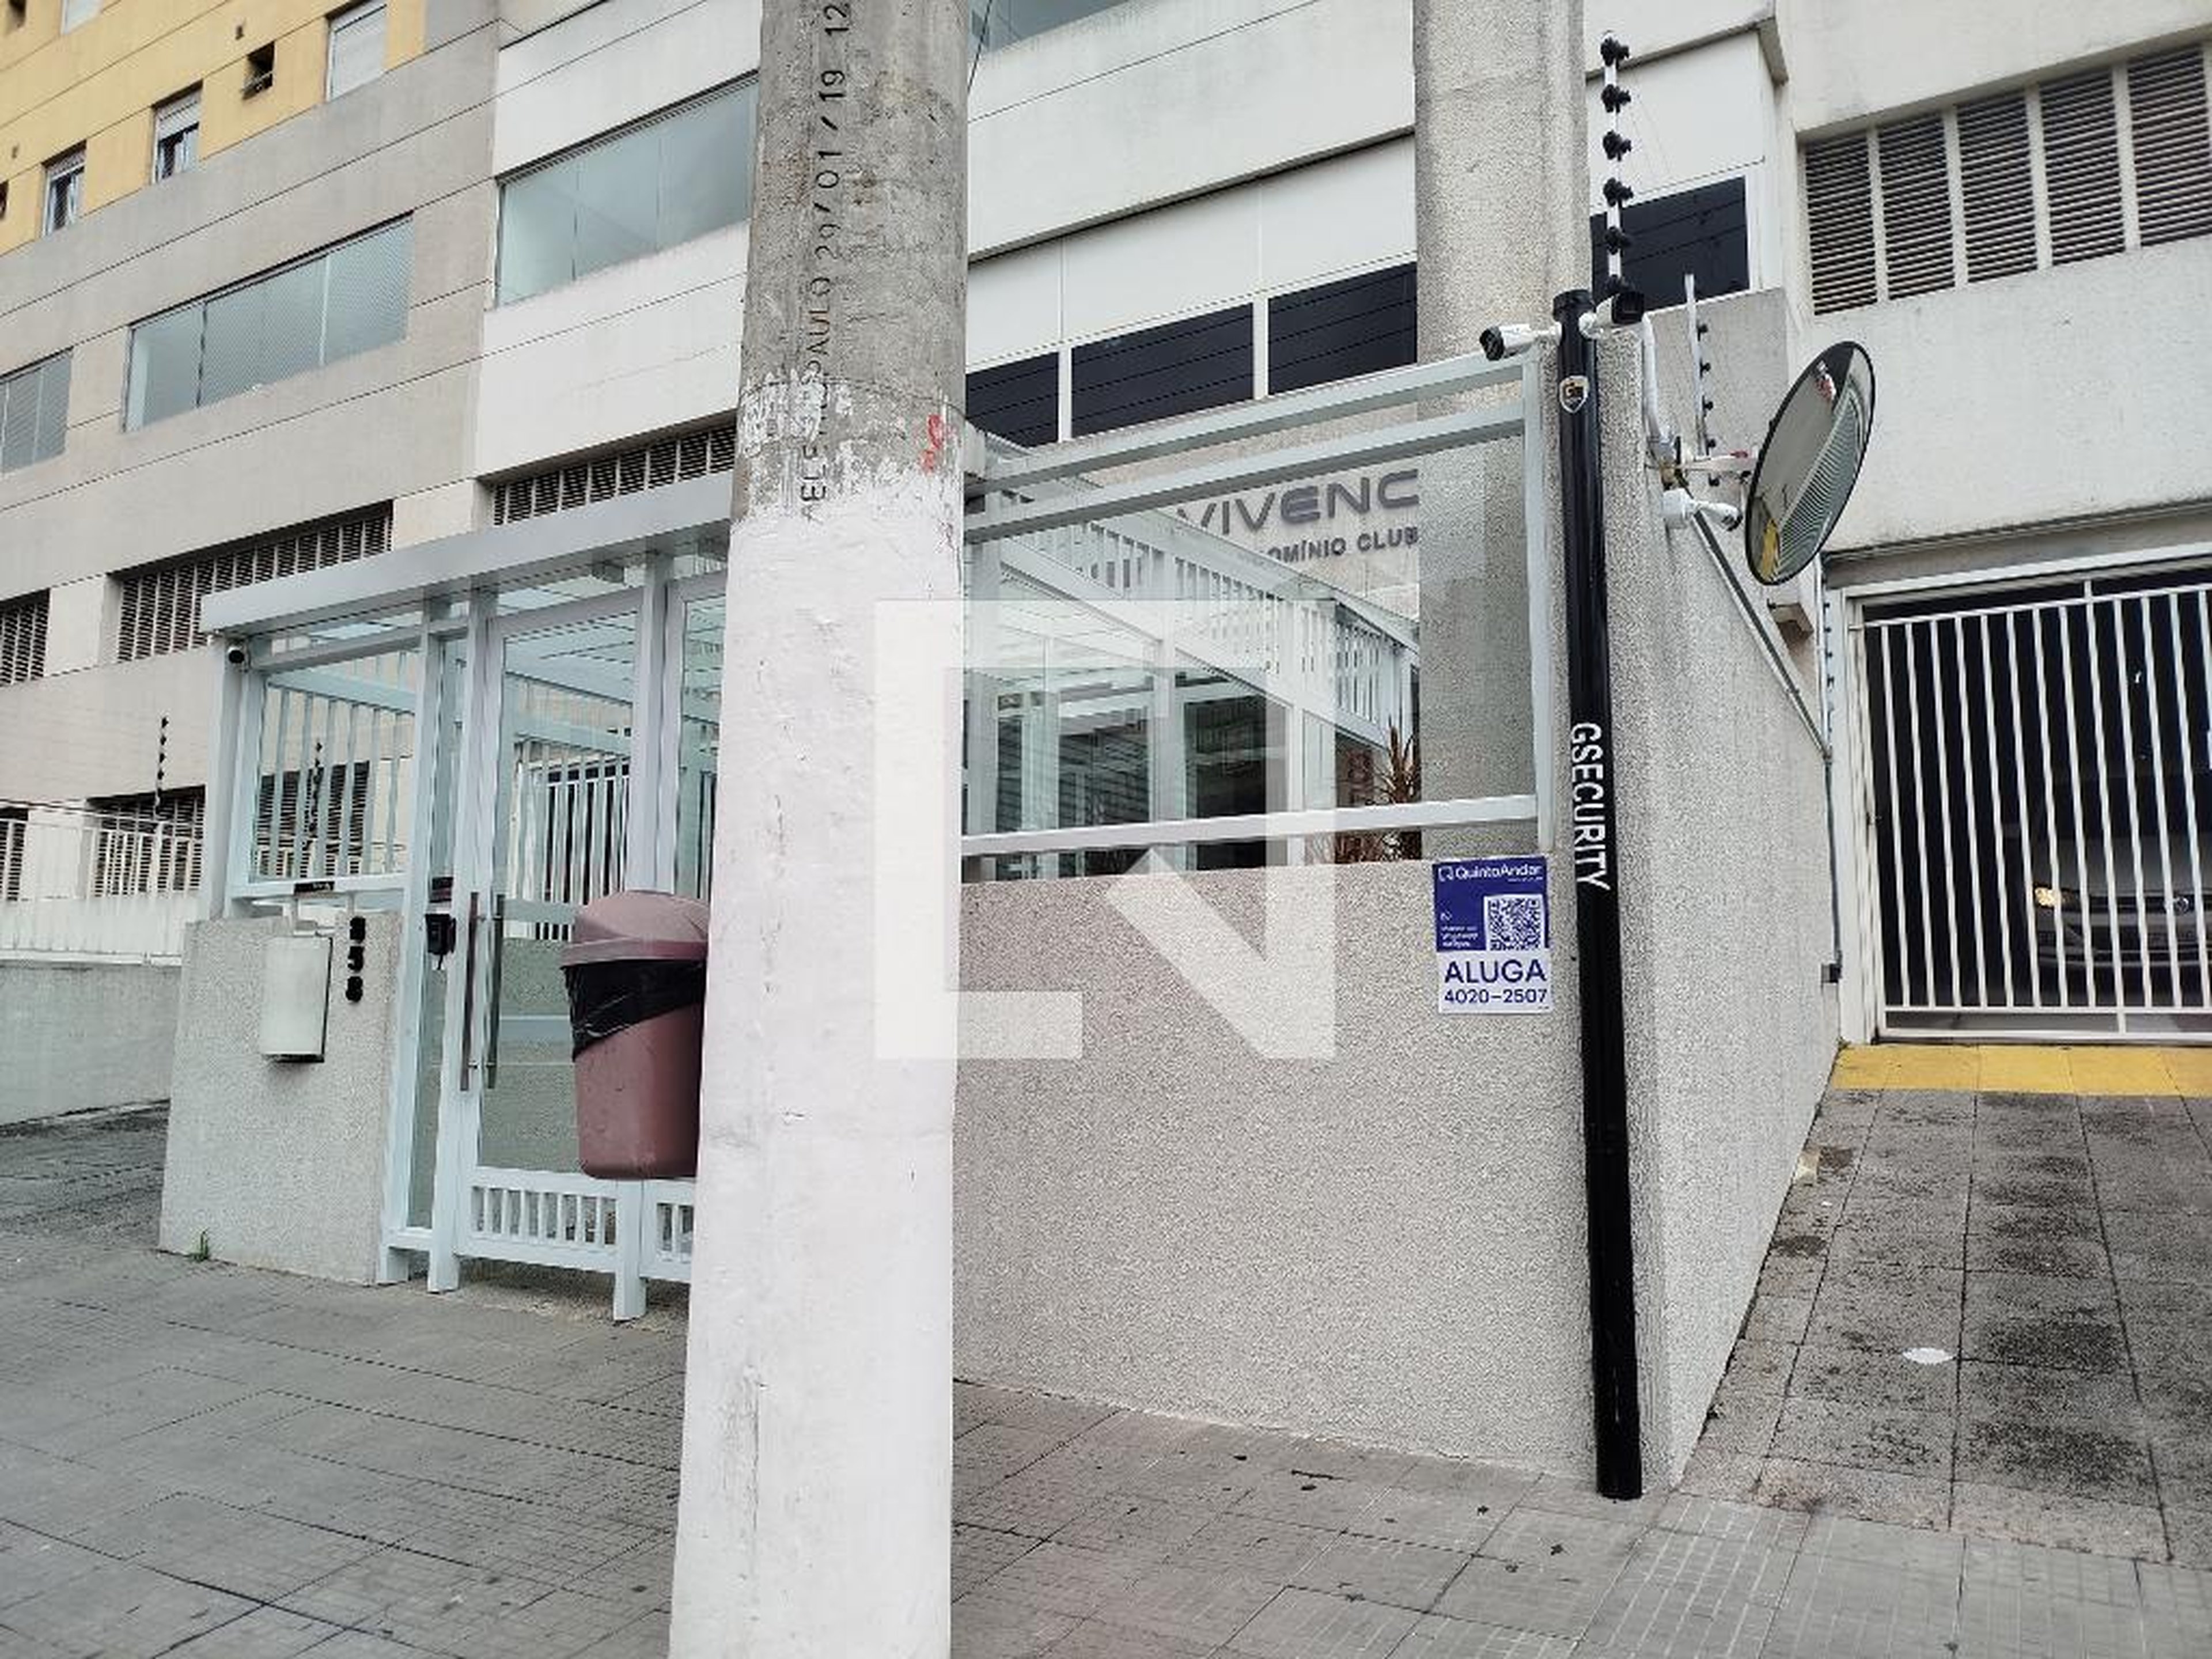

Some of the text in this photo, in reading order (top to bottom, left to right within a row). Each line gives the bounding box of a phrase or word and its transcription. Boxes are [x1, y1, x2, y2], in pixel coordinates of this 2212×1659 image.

[1571, 722, 1611, 891] GSECURITY
[1455, 863, 1543, 880] QuintoAndar
[1444, 958, 1548, 983] ALUGA
[1444, 988, 1548, 1004] 4020-2507
